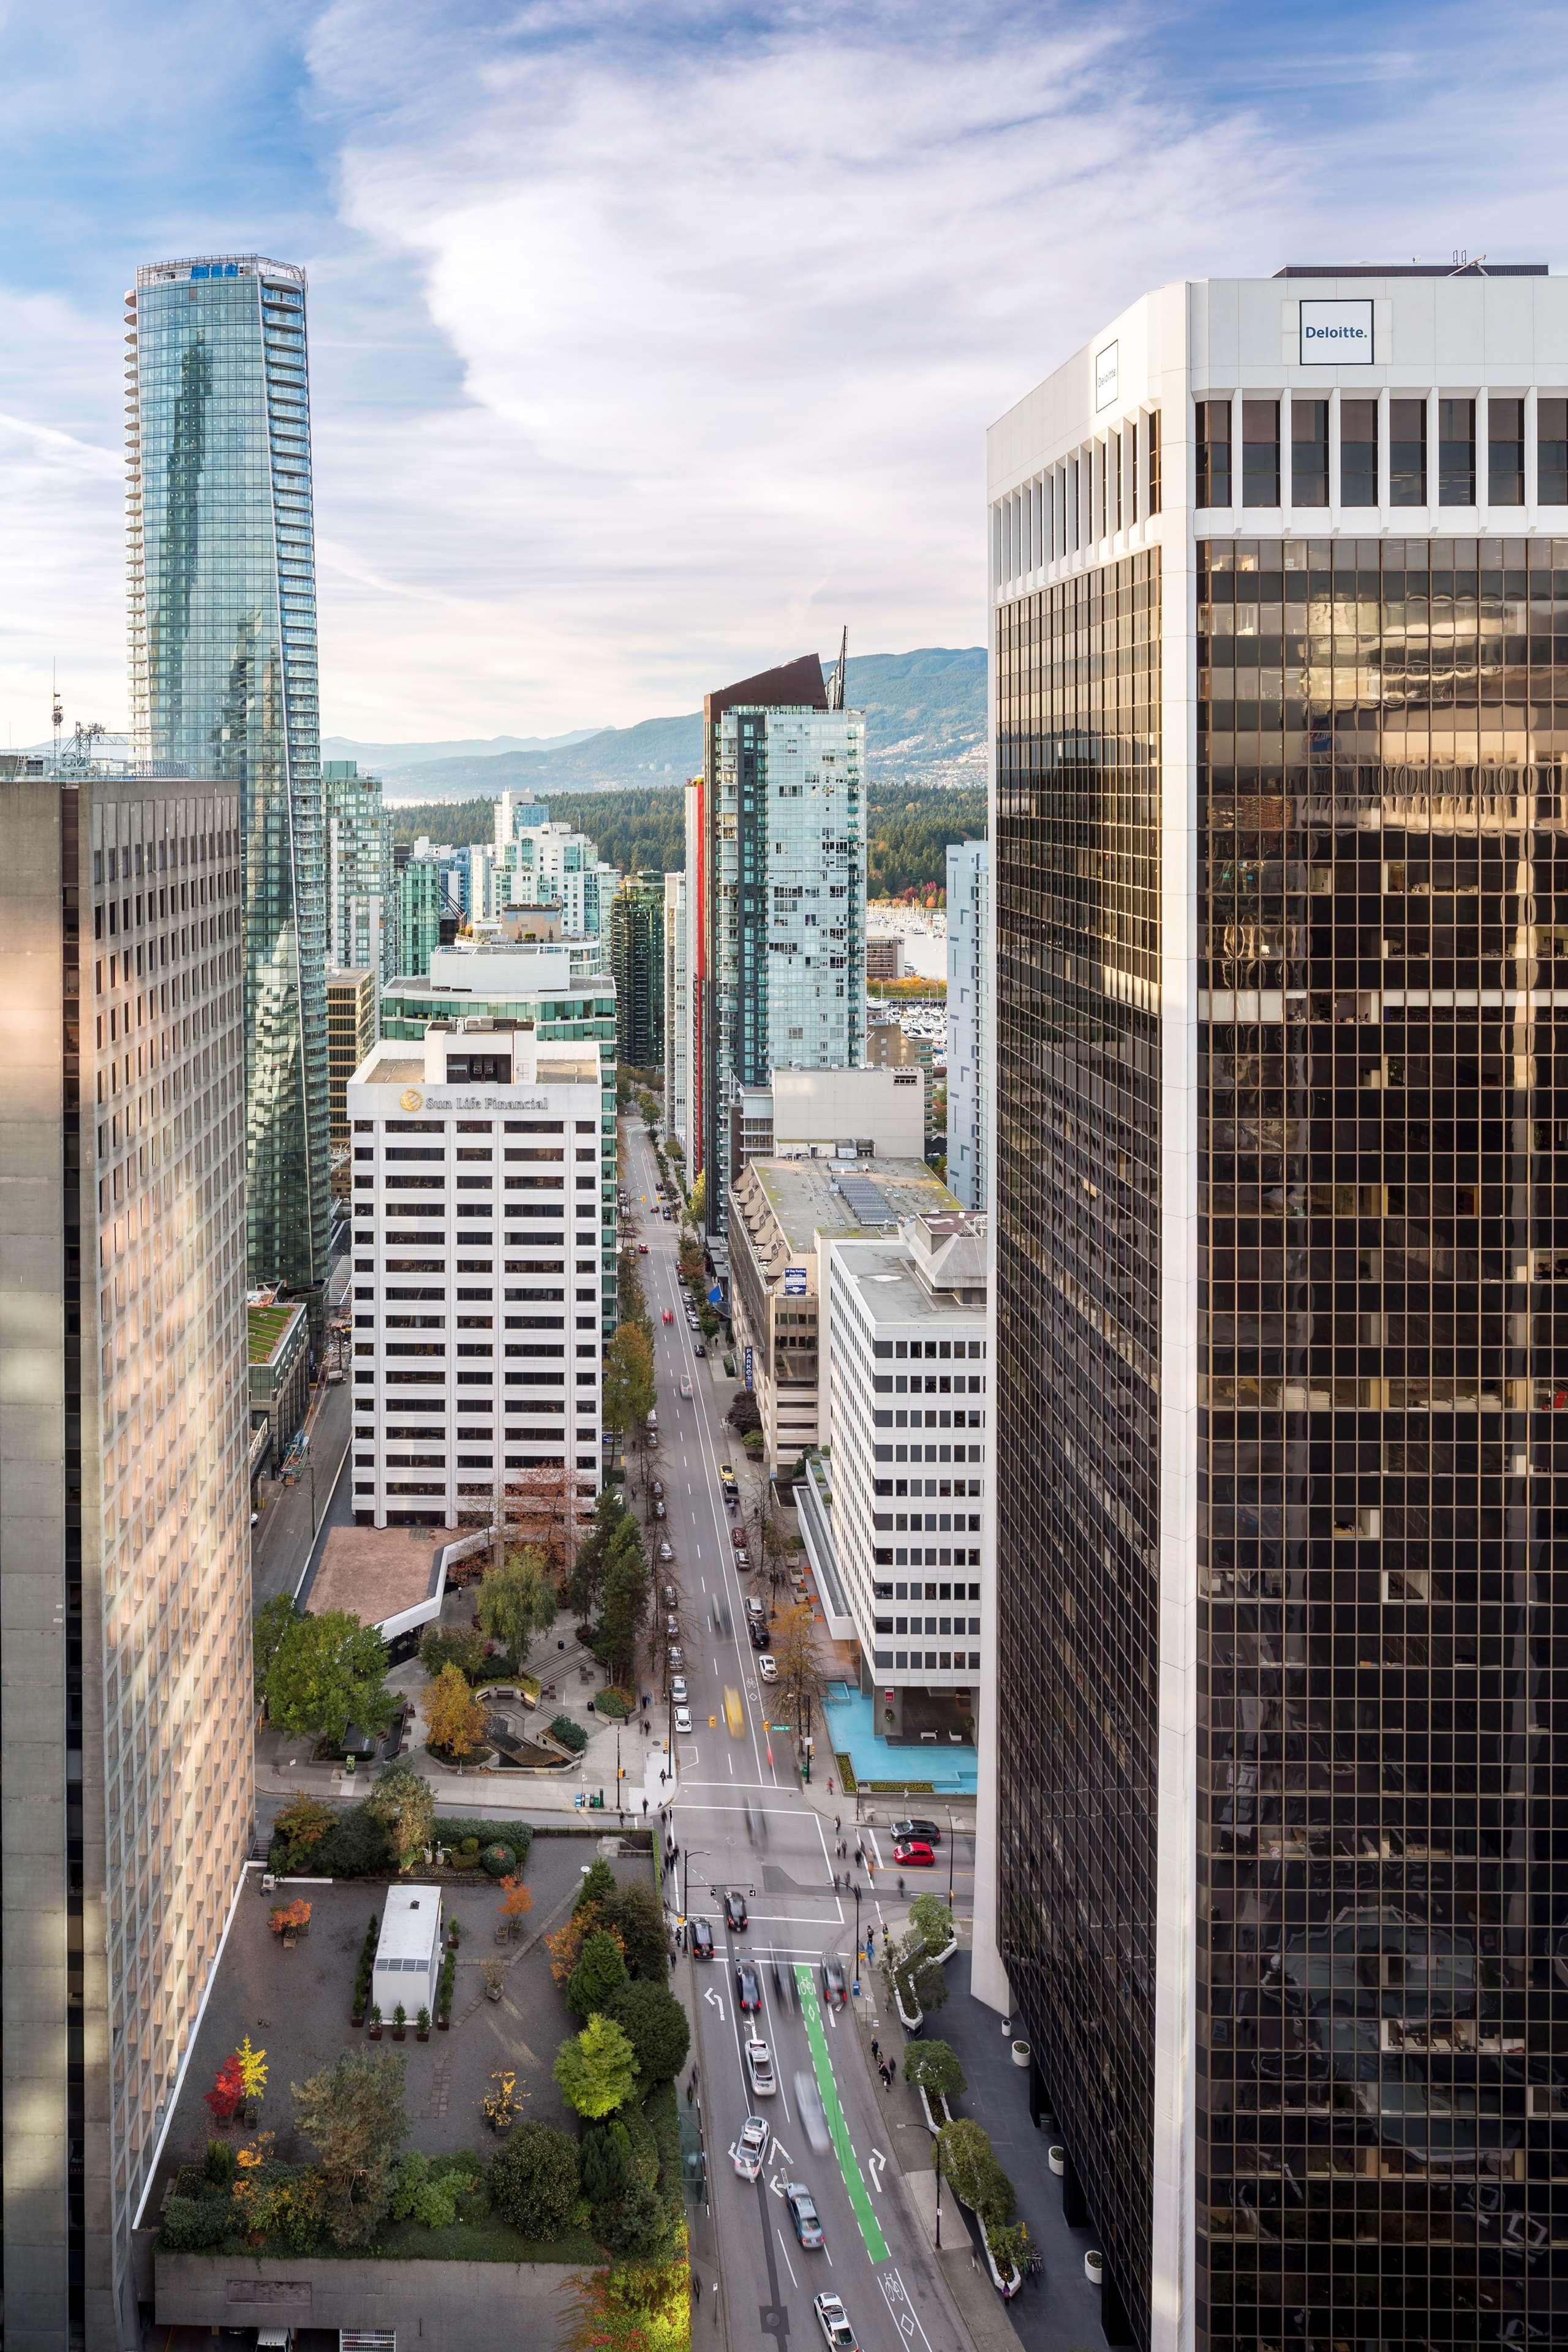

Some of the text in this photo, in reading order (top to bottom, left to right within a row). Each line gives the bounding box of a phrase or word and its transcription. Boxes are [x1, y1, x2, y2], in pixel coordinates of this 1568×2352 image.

[1305, 326, 1368, 338] Deloitte.
[426, 1097, 549, 1109] Sun Life Financial
